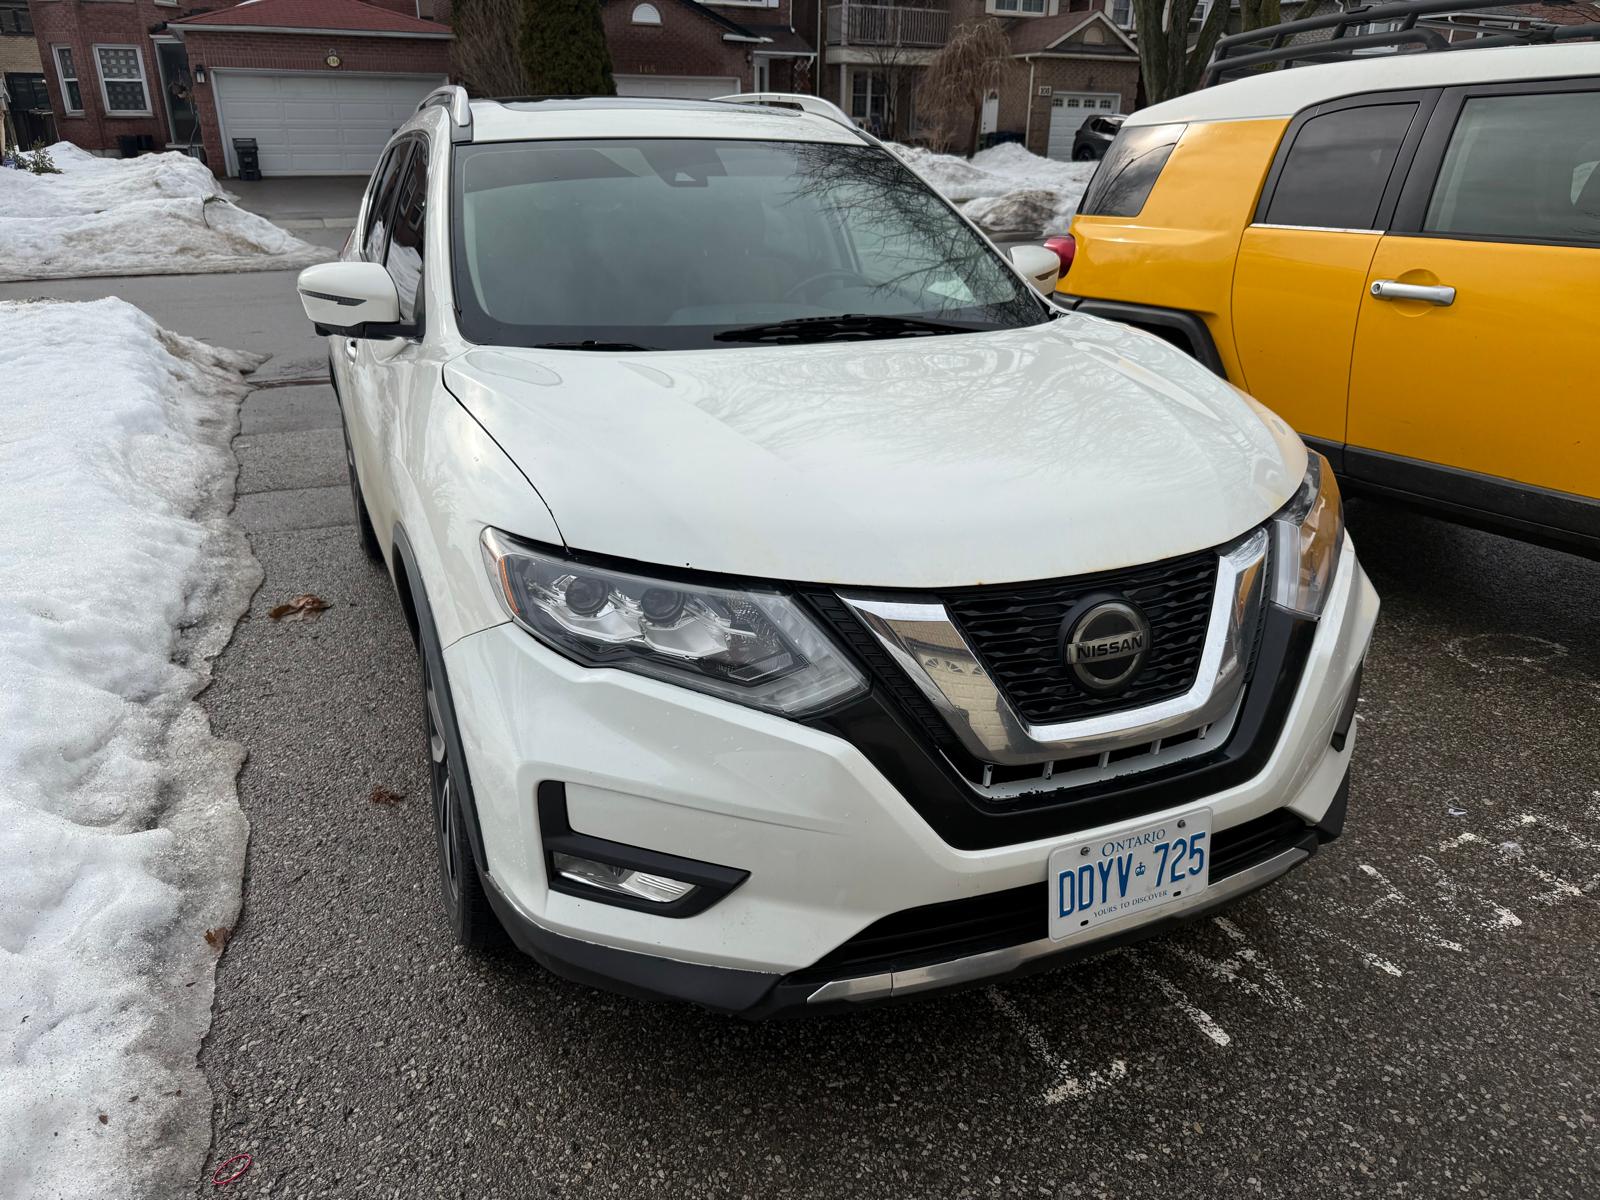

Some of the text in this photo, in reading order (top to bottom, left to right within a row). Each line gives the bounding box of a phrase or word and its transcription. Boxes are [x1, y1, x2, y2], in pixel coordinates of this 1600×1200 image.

[1078, 635, 1142, 659] NISSAN
[1102, 828, 1166, 857] ONTARIO
[1059, 831, 1206, 918] DDYV 725
[1093, 889, 1168, 918] YOURS TO DISCOVER
